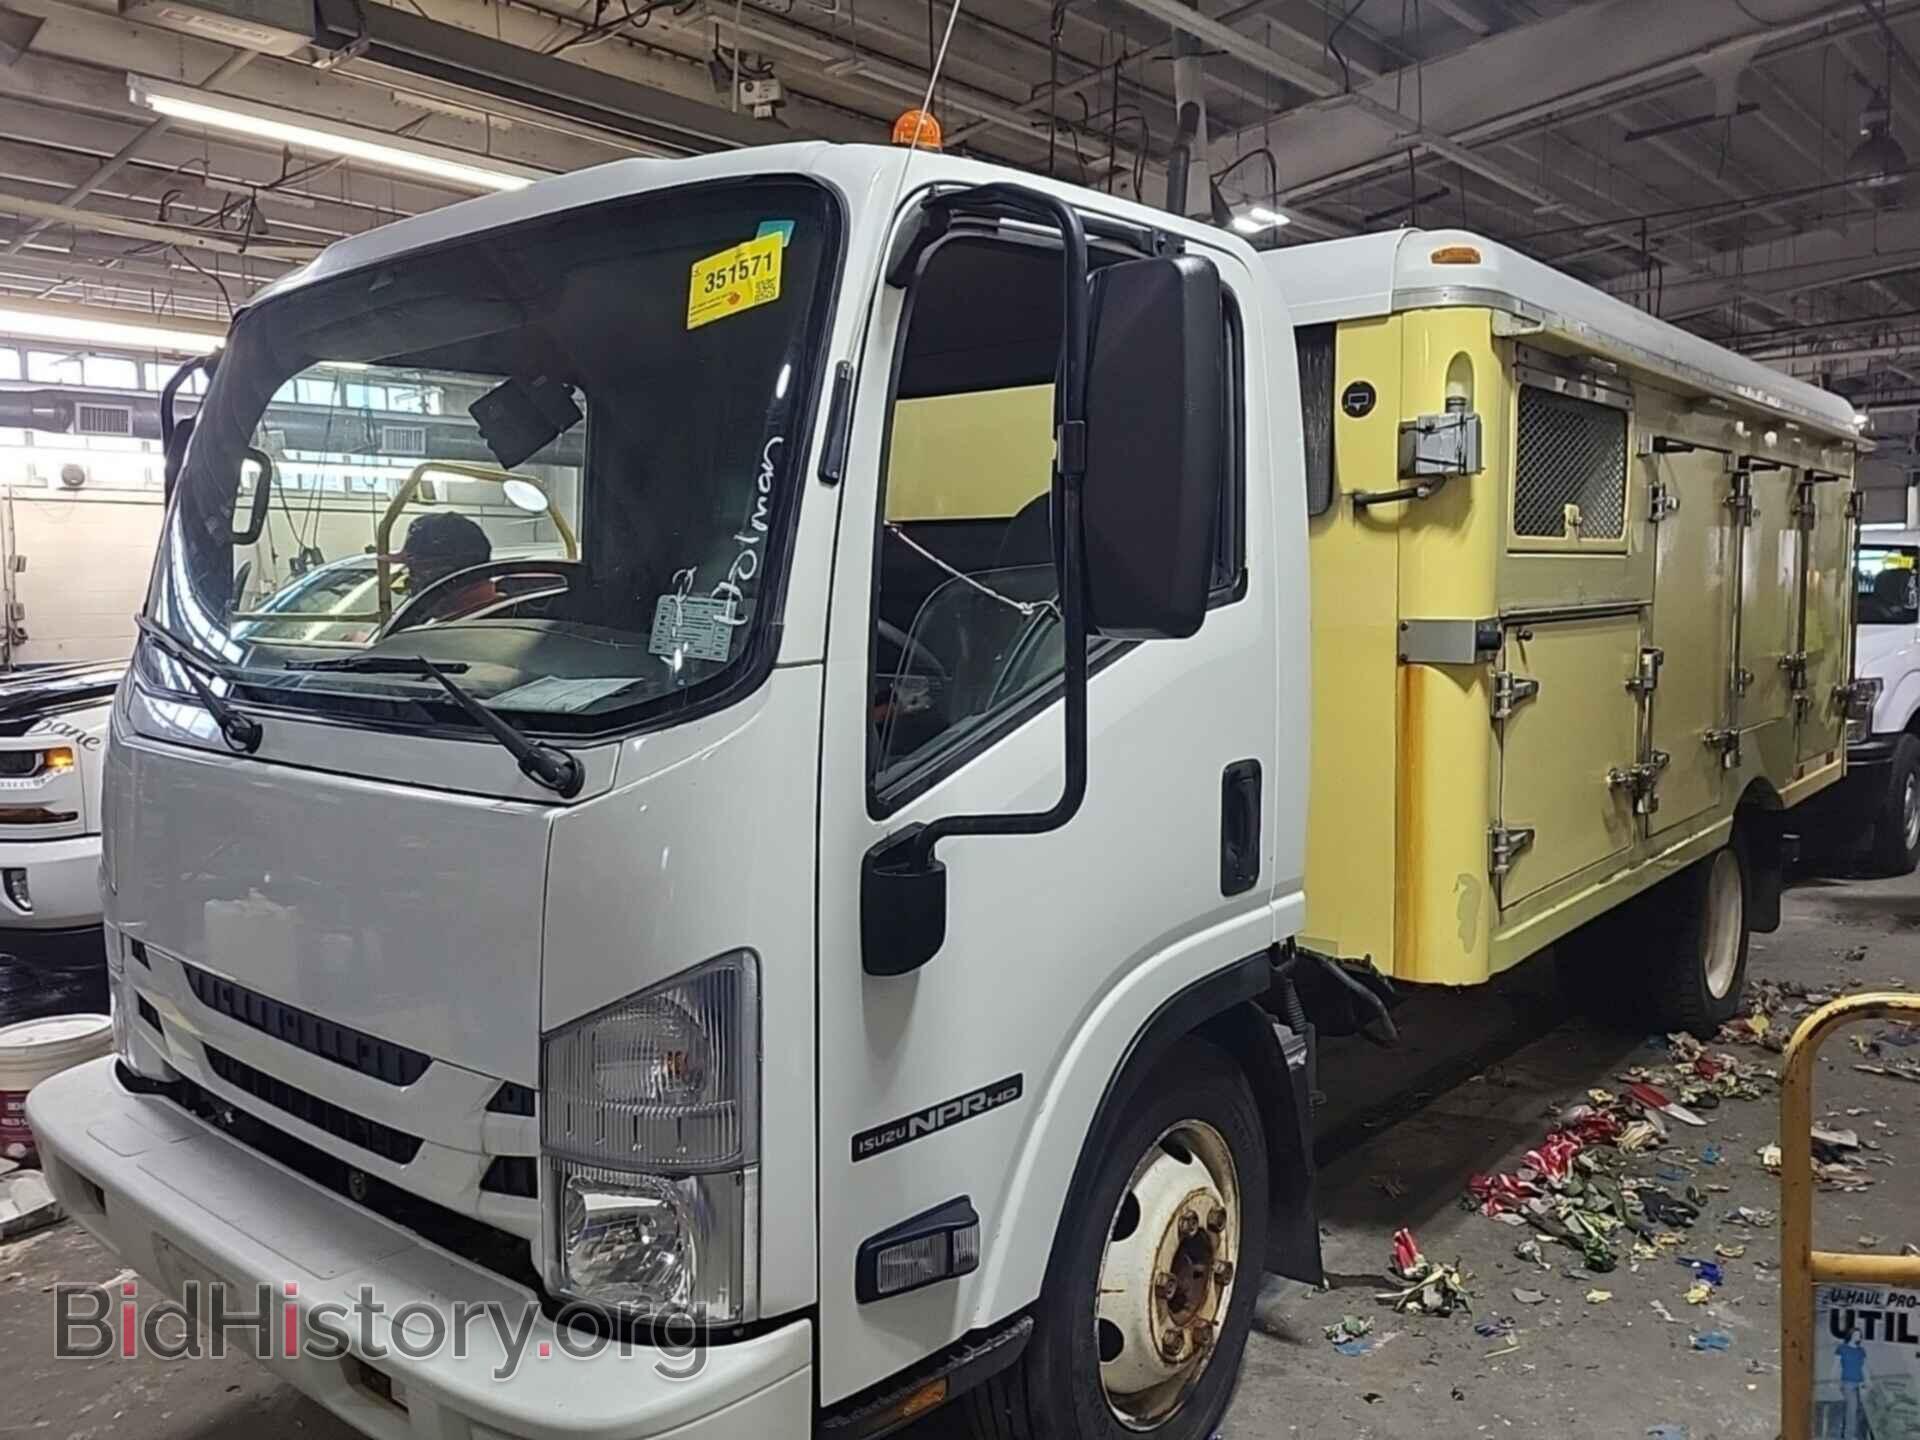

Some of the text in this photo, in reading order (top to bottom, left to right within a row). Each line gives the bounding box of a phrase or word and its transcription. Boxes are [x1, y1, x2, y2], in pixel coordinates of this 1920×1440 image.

[703, 250, 773, 294] 351571
[858, 1125, 907, 1153] ISUZU
[908, 1090, 986, 1138] NPR
[1831, 1288, 1882, 1305] U-HAUL
[1829, 1308, 1919, 1344] UTIL
